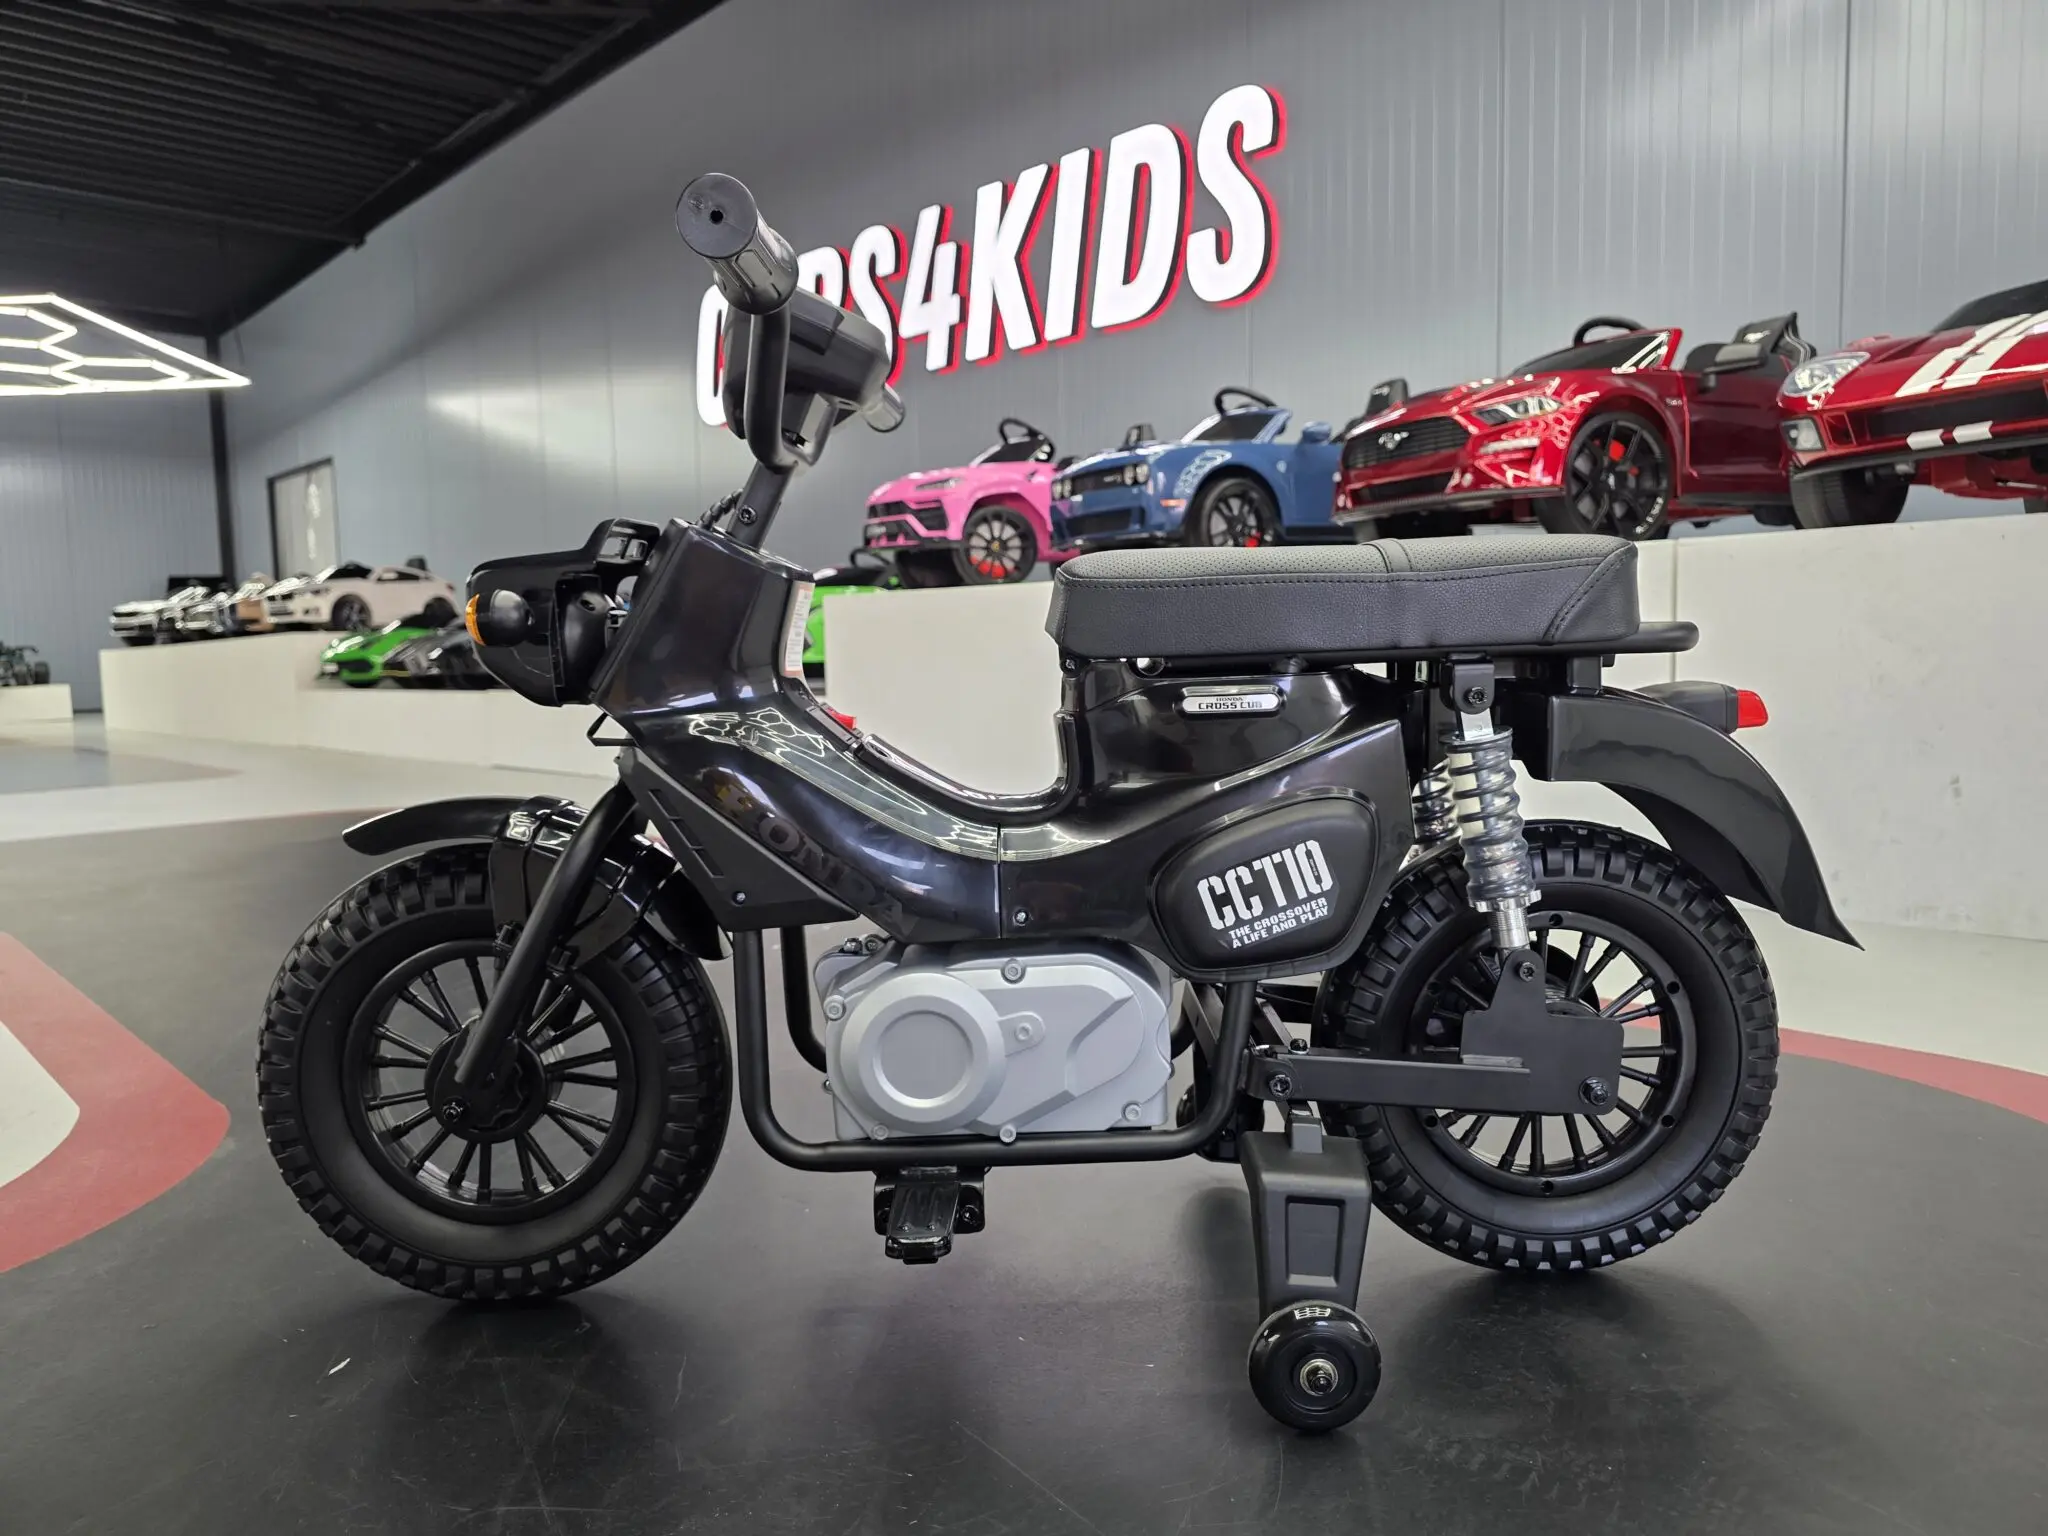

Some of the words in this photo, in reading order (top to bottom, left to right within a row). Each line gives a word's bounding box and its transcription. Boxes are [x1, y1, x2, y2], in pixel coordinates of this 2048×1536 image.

[697, 84, 1280, 426] CS4KIDS
[1198, 702, 1237, 710] CROSS
[1228, 924, 1252, 939] THE
[1253, 897, 1328, 930] CROSSOVER
[1232, 939, 1242, 949] A
[1243, 929, 1269, 945] LIFE
[1272, 919, 1297, 935] AND
[1300, 906, 1329, 924] PLAY
